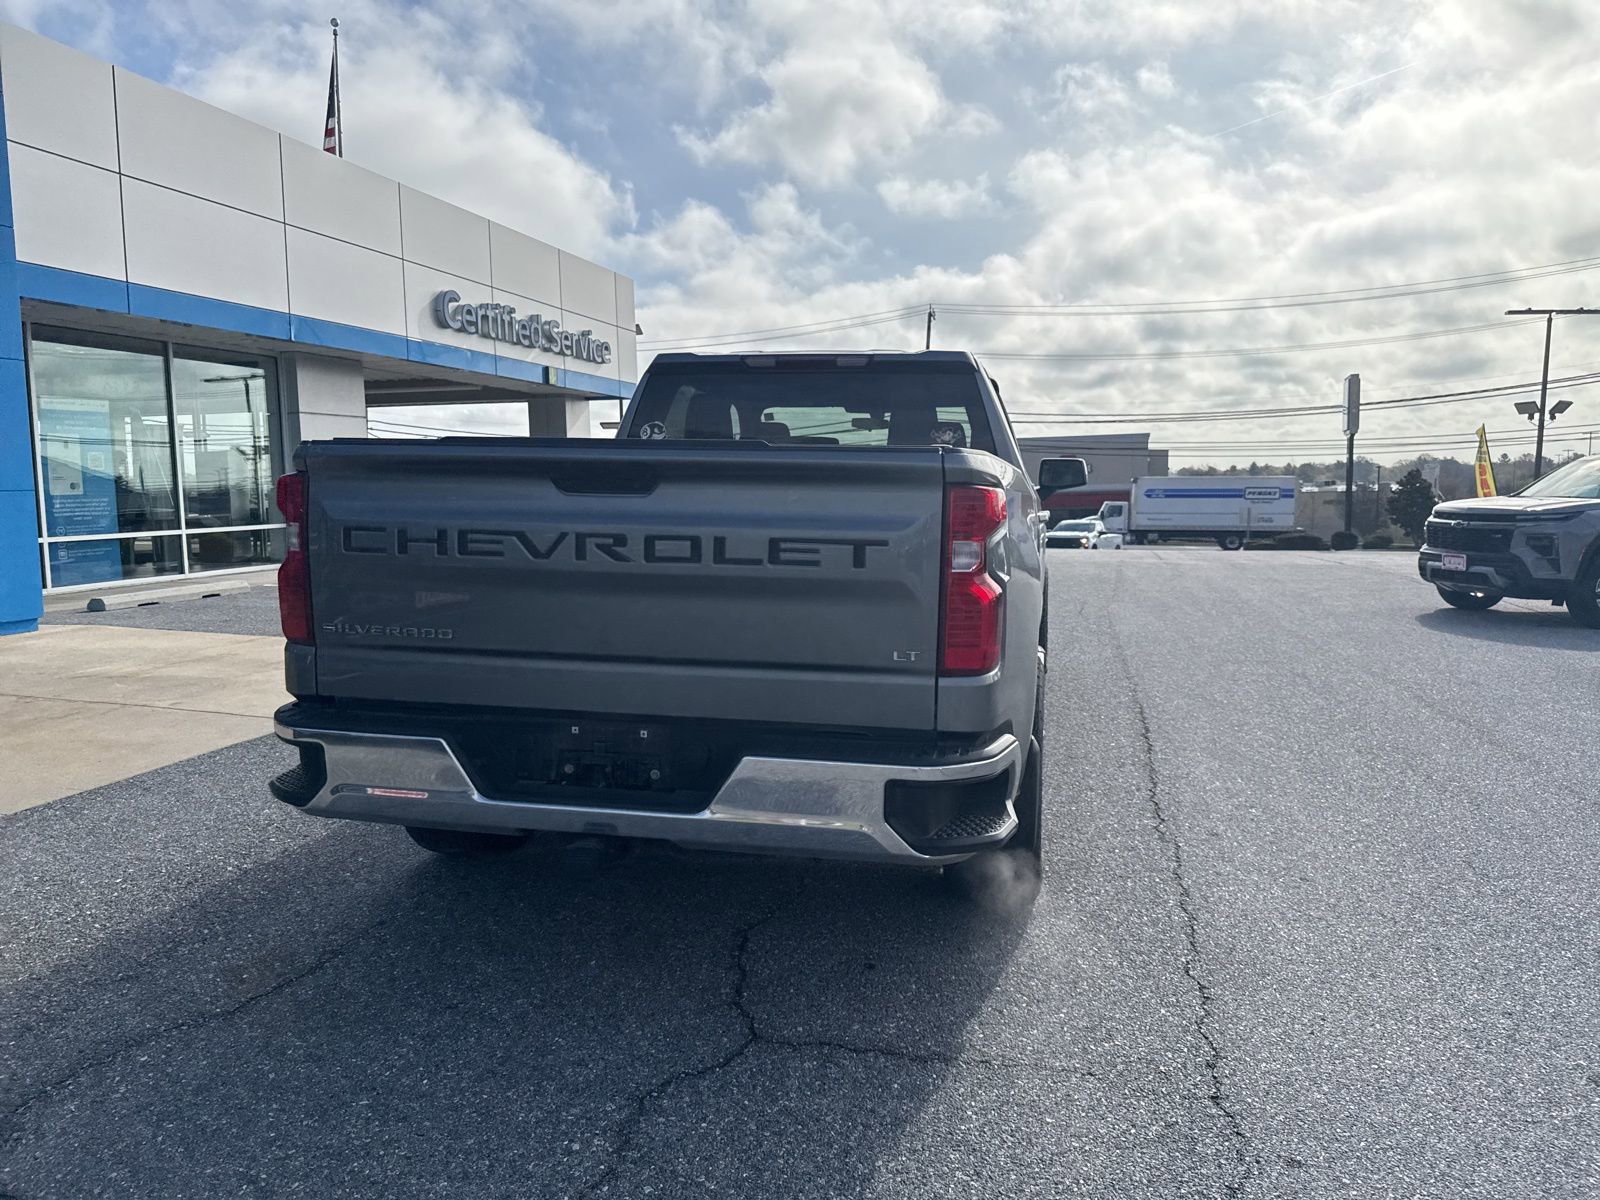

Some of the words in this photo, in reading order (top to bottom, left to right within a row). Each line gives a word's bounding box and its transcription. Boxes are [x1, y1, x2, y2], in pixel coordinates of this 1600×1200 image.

[435, 289, 543, 348] Certified
[545, 319, 612, 364] Service
[342, 526, 889, 569] CHEVROLET
[322, 623, 453, 639] SILVERADO
[893, 650, 921, 661] LT
